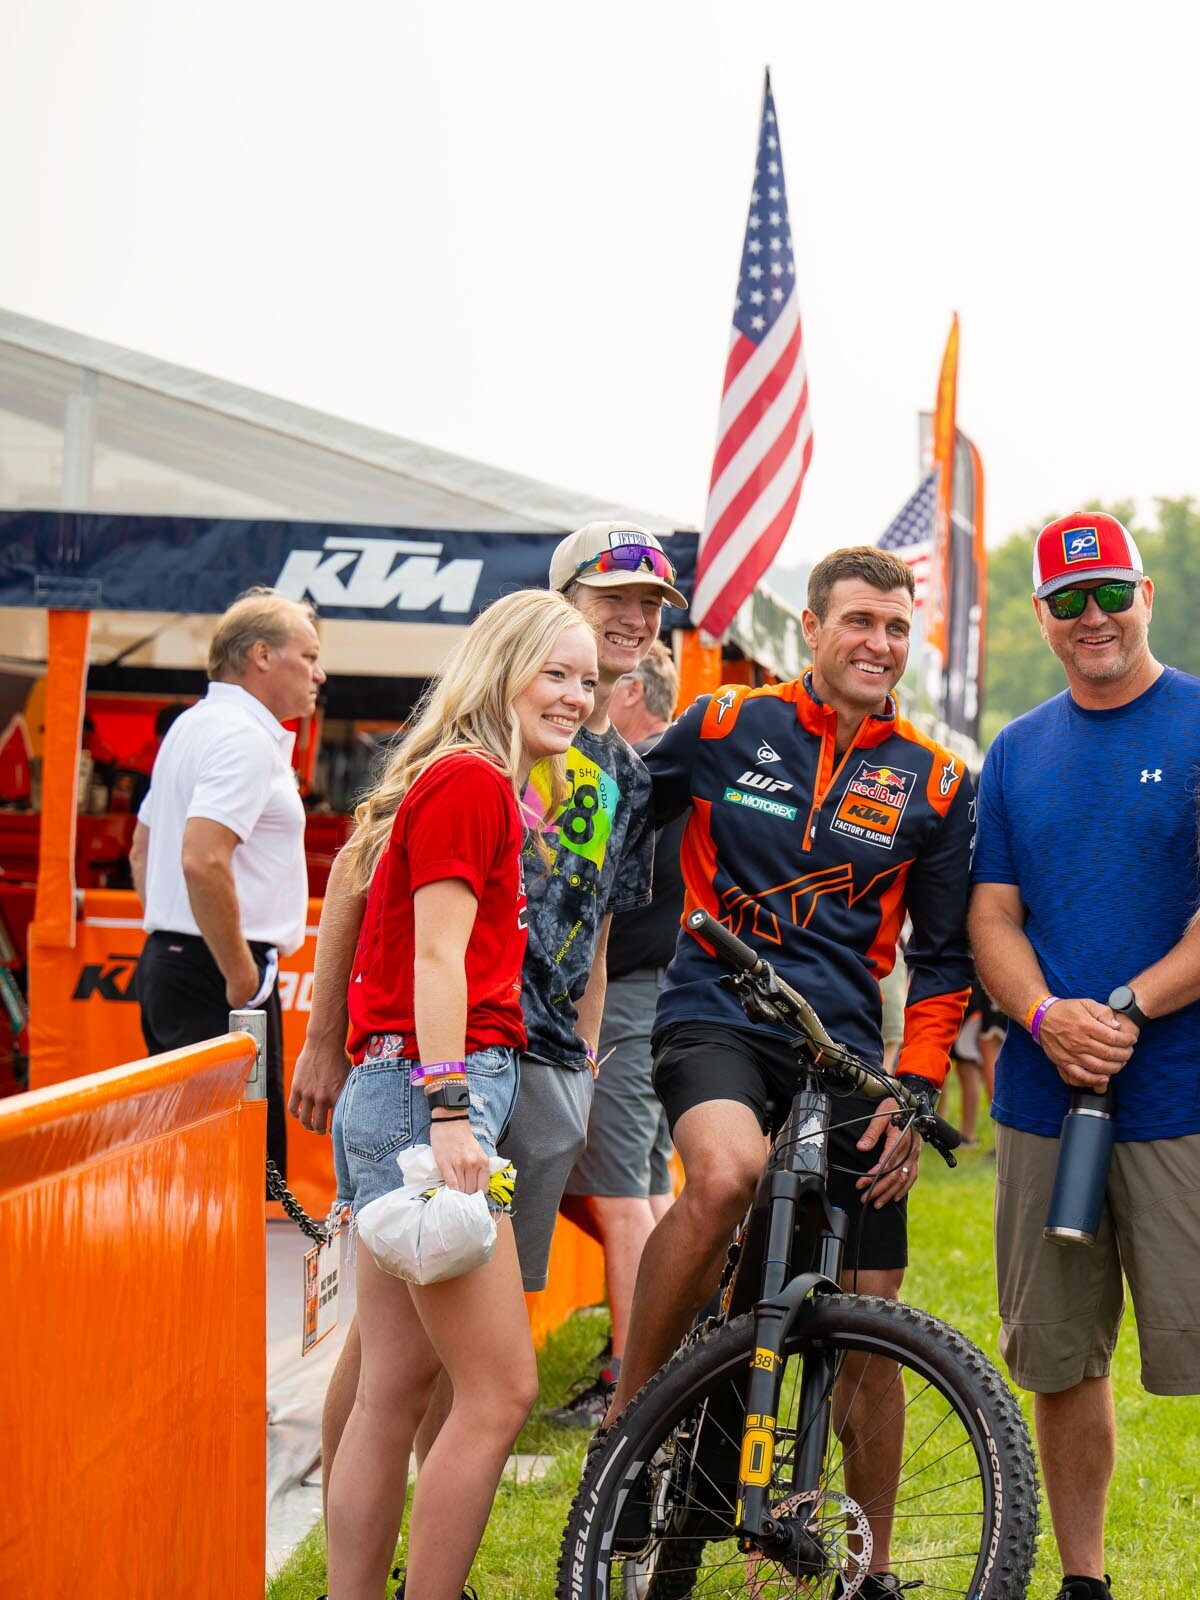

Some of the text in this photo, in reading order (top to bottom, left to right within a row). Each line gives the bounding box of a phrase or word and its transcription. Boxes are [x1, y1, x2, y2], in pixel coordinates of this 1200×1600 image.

[1069, 535, 1096, 554] 50
[273, 536, 484, 613] KTM
[736, 771, 794, 792] WP
[741, 794, 795, 818] MOTOREX
[847, 804, 890, 825] KTM
[834, 819, 864, 836] FACTORY
[865, 830, 891, 844] RACING
[756, 1353, 772, 1367] 38
[984, 1437, 1003, 1579] SCORPION
